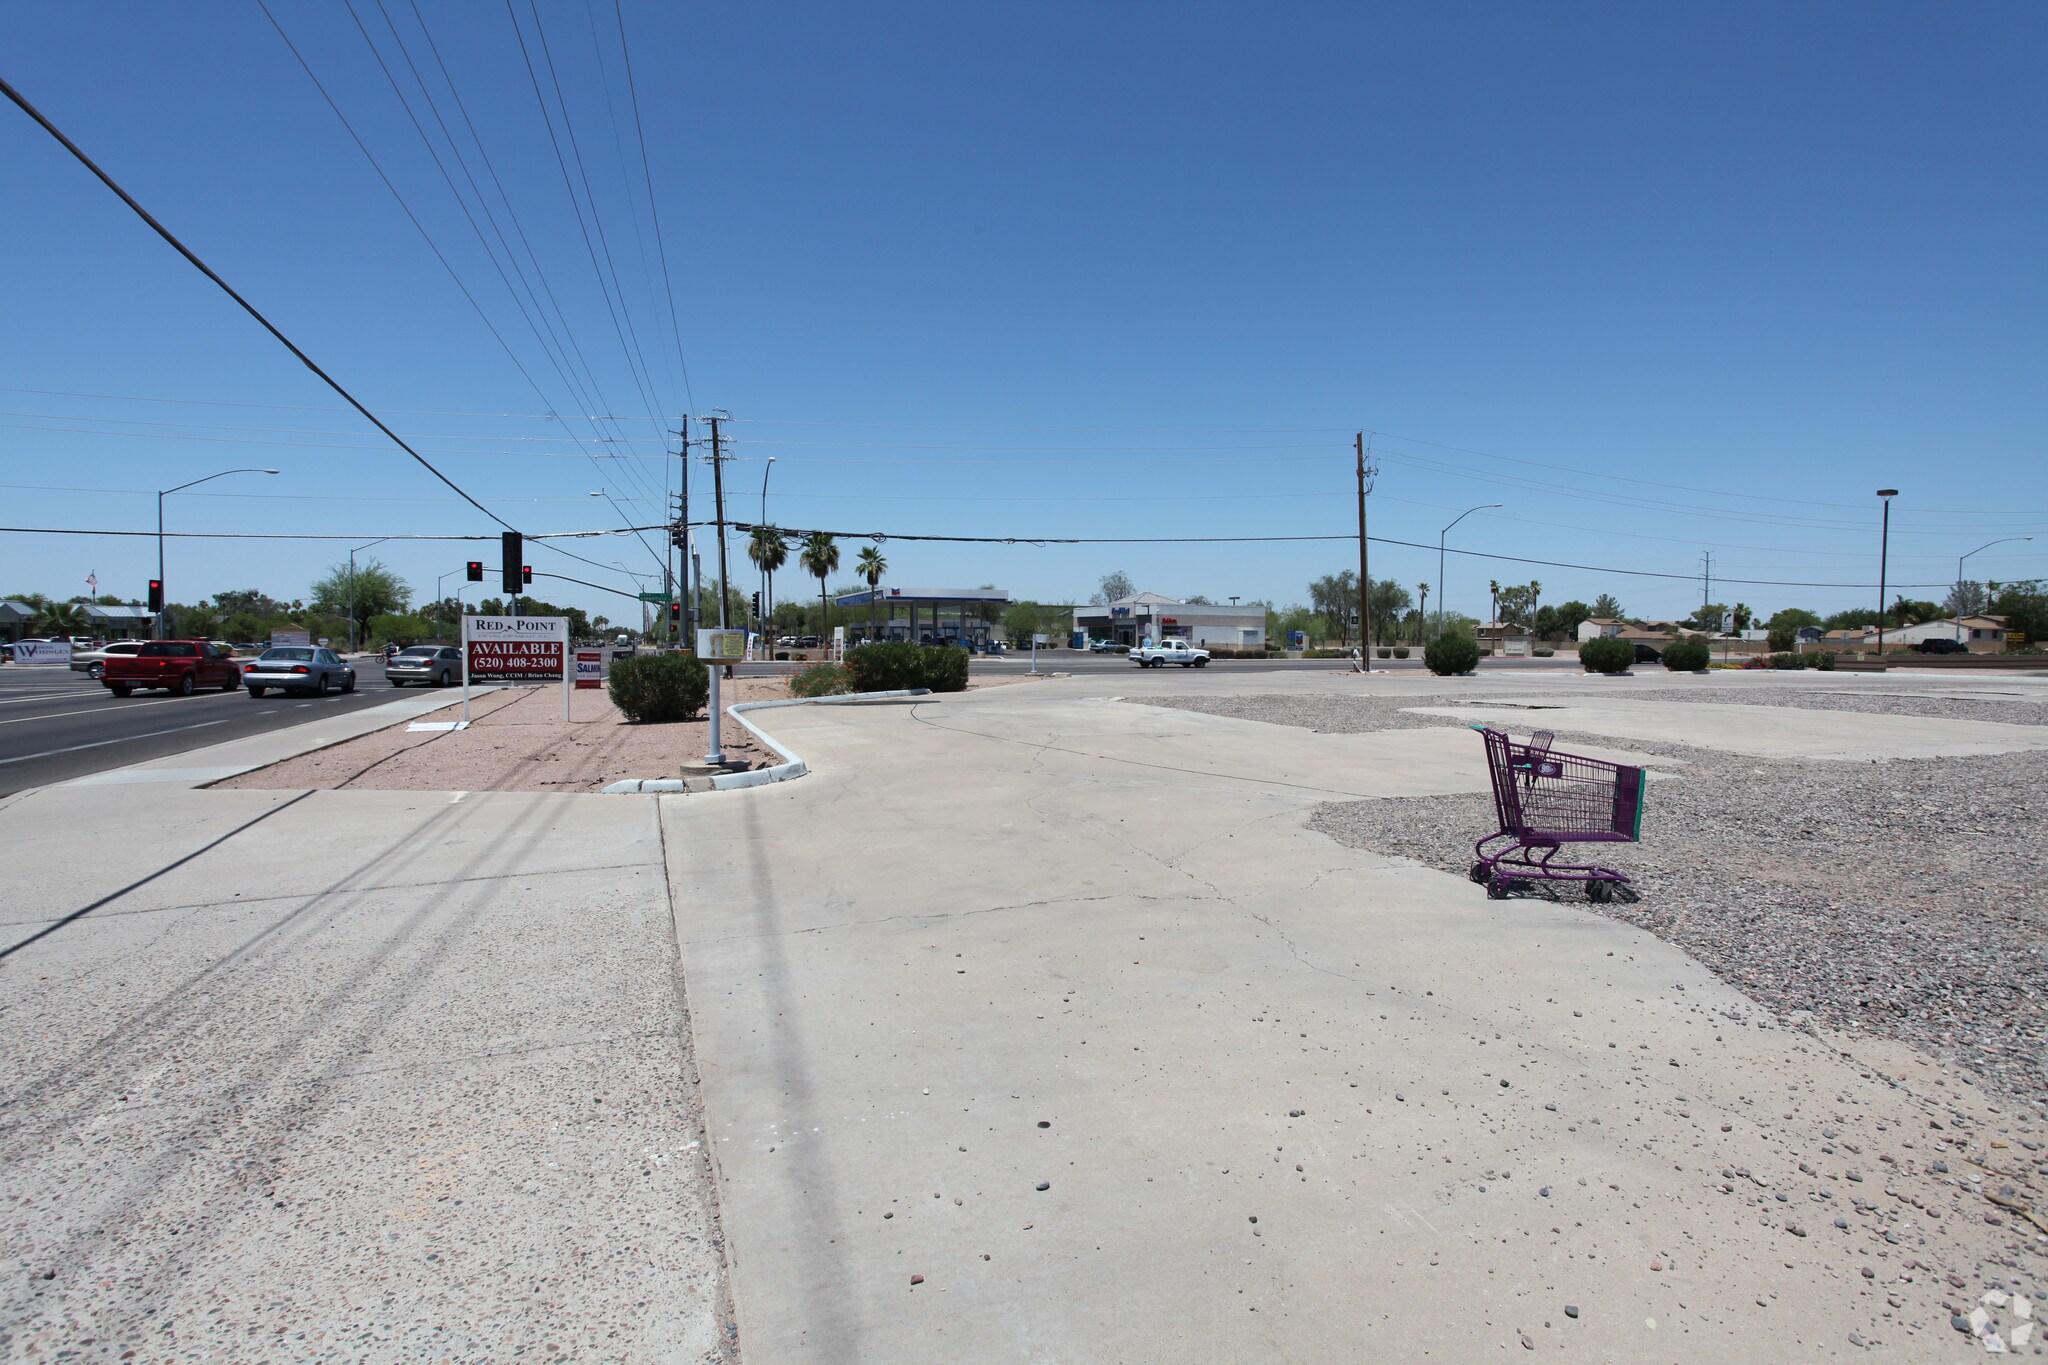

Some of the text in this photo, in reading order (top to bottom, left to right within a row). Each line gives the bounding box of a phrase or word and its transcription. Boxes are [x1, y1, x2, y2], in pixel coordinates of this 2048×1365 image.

[476, 620, 556, 631] RED POINT
[472, 643, 560, 655] AVAILABLE
[474, 657, 557, 670] (520) 408-2300
